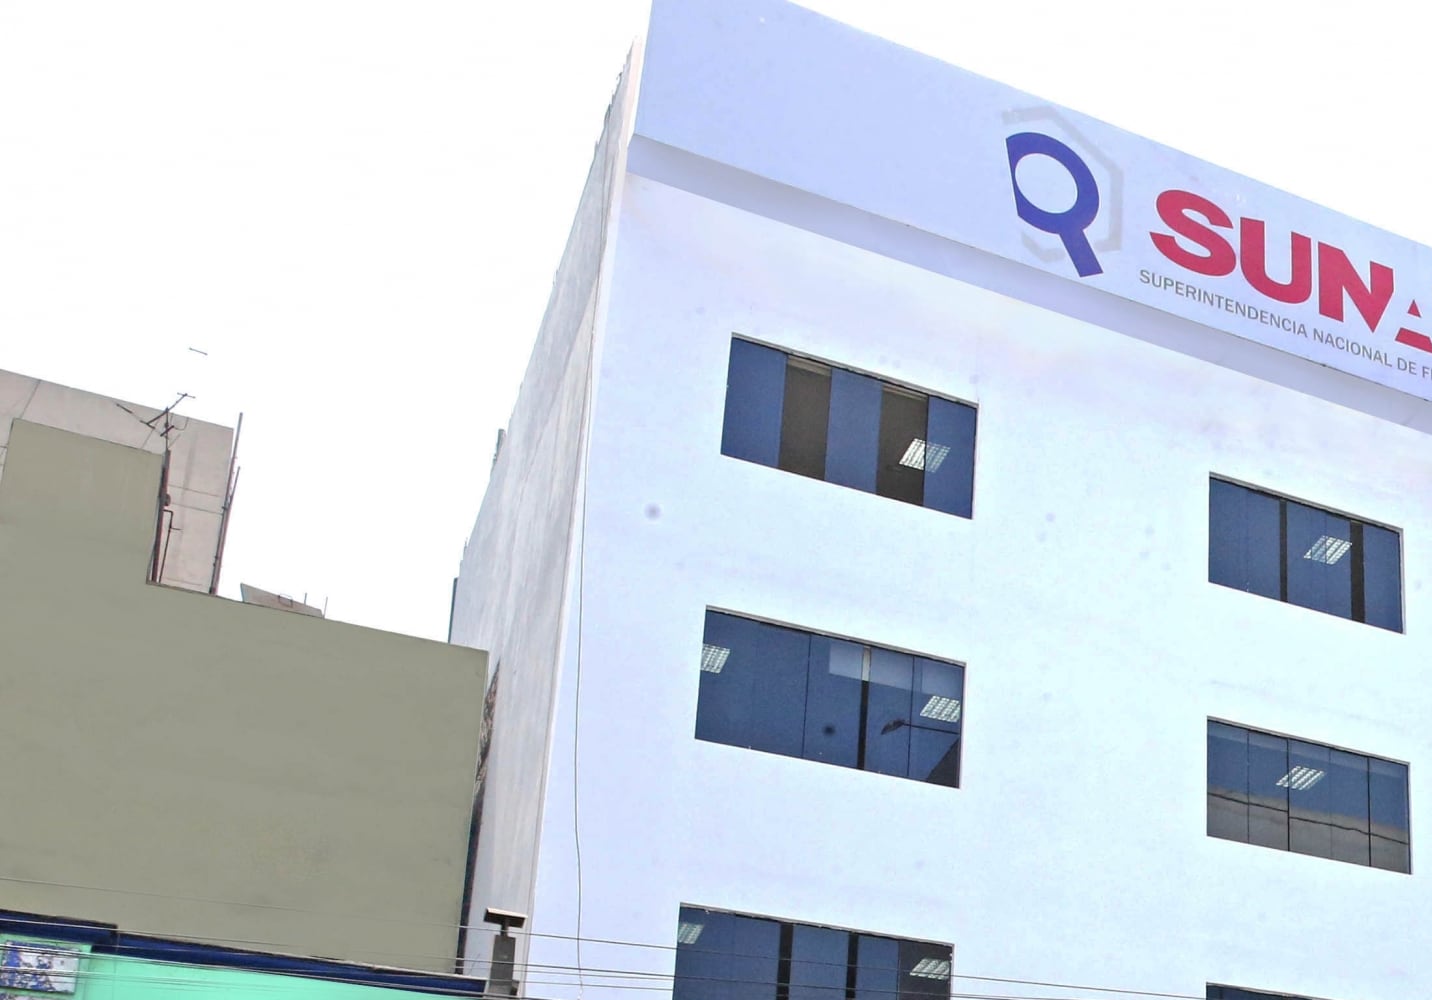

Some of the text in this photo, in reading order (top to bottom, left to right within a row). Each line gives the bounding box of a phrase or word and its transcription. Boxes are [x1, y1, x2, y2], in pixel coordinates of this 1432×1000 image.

[1139, 268, 1309, 338] SUPERINTENDENCIA
[1312, 328, 1393, 369] NACIONAL
[1396, 357, 1418, 376] DE
